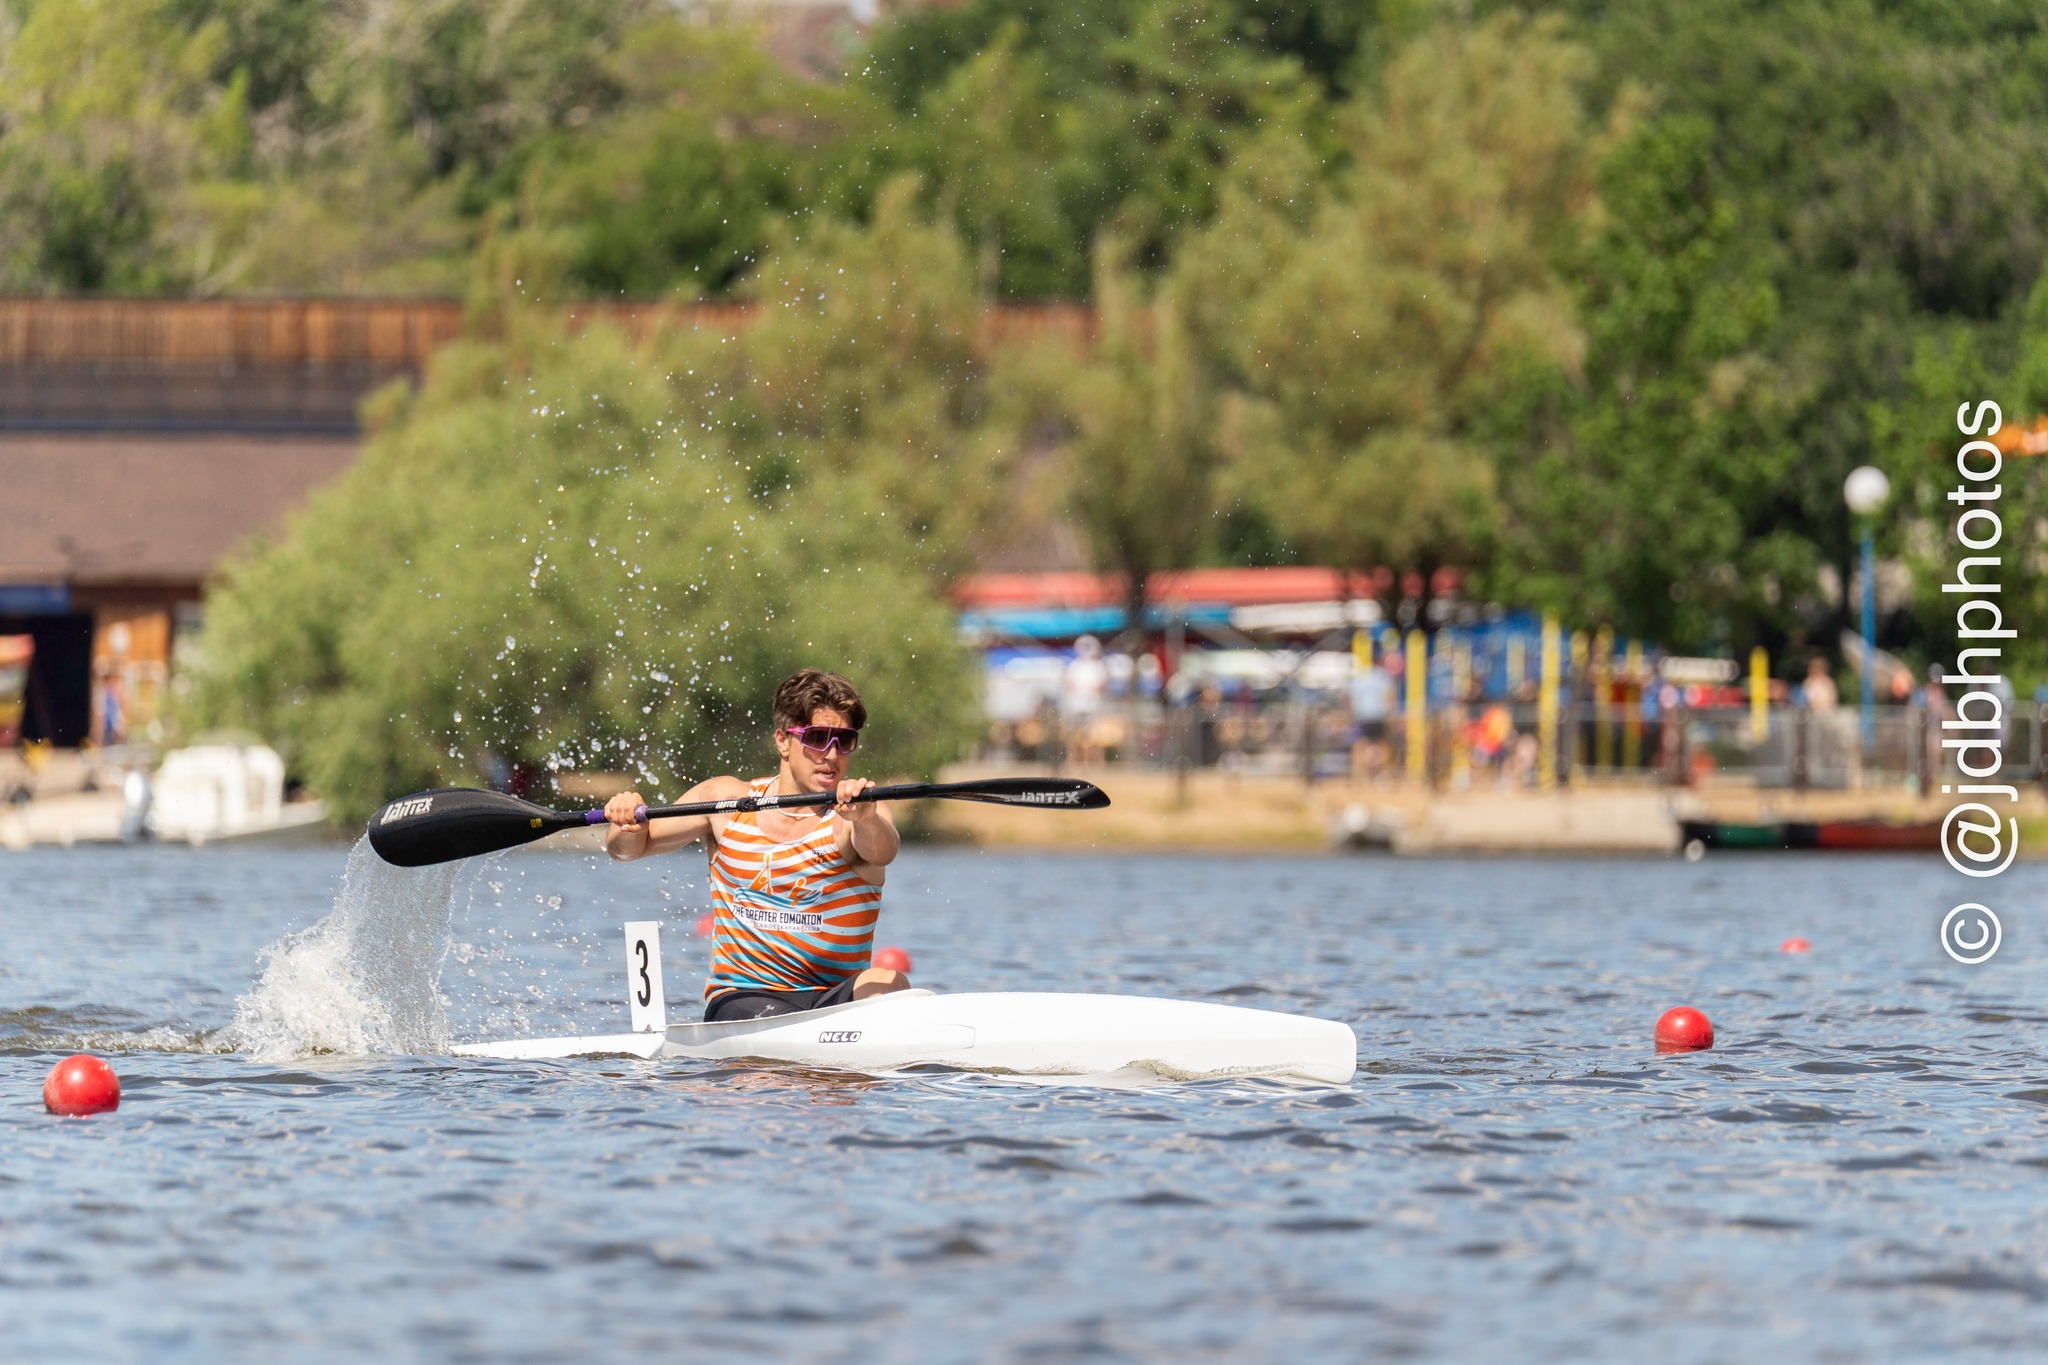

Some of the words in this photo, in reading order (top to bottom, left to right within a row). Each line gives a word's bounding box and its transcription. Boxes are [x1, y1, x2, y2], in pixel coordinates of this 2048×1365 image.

[732, 904, 745, 918] THE
[745, 908, 778, 923] GREATER
[779, 912, 822, 926] EDMONTON
[635, 939, 651, 1008] 3
[819, 1031, 862, 1043] NELO
